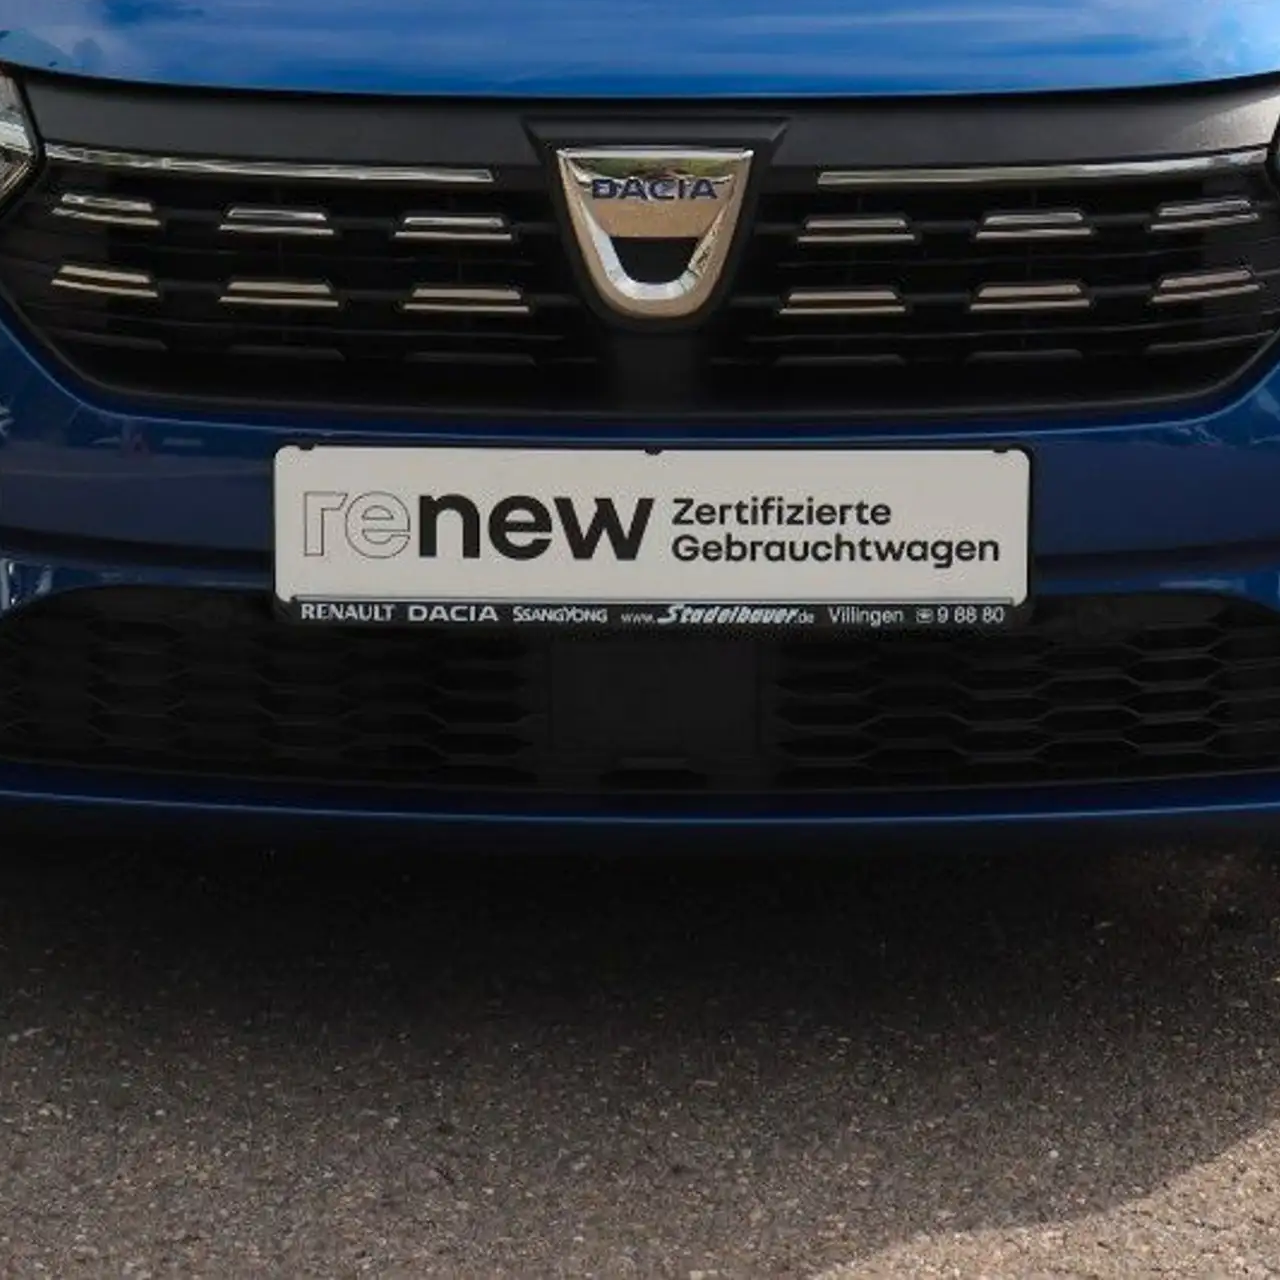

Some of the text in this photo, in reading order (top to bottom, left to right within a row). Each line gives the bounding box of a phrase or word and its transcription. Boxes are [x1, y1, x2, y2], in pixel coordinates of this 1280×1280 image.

[591, 178, 718, 201] DACIA
[302, 489, 656, 561] renew
[671, 496, 893, 527] Zertifizierte
[671, 532, 1001, 570] Gebrauchtwagen
[300, 603, 395, 621] RENAULT
[407, 605, 499, 622] DACIA
[827, 606, 904, 627] Villingen
[937, 606, 949, 623] 9
[953, 606, 978, 623] 88
[982, 606, 1005, 623] 80
